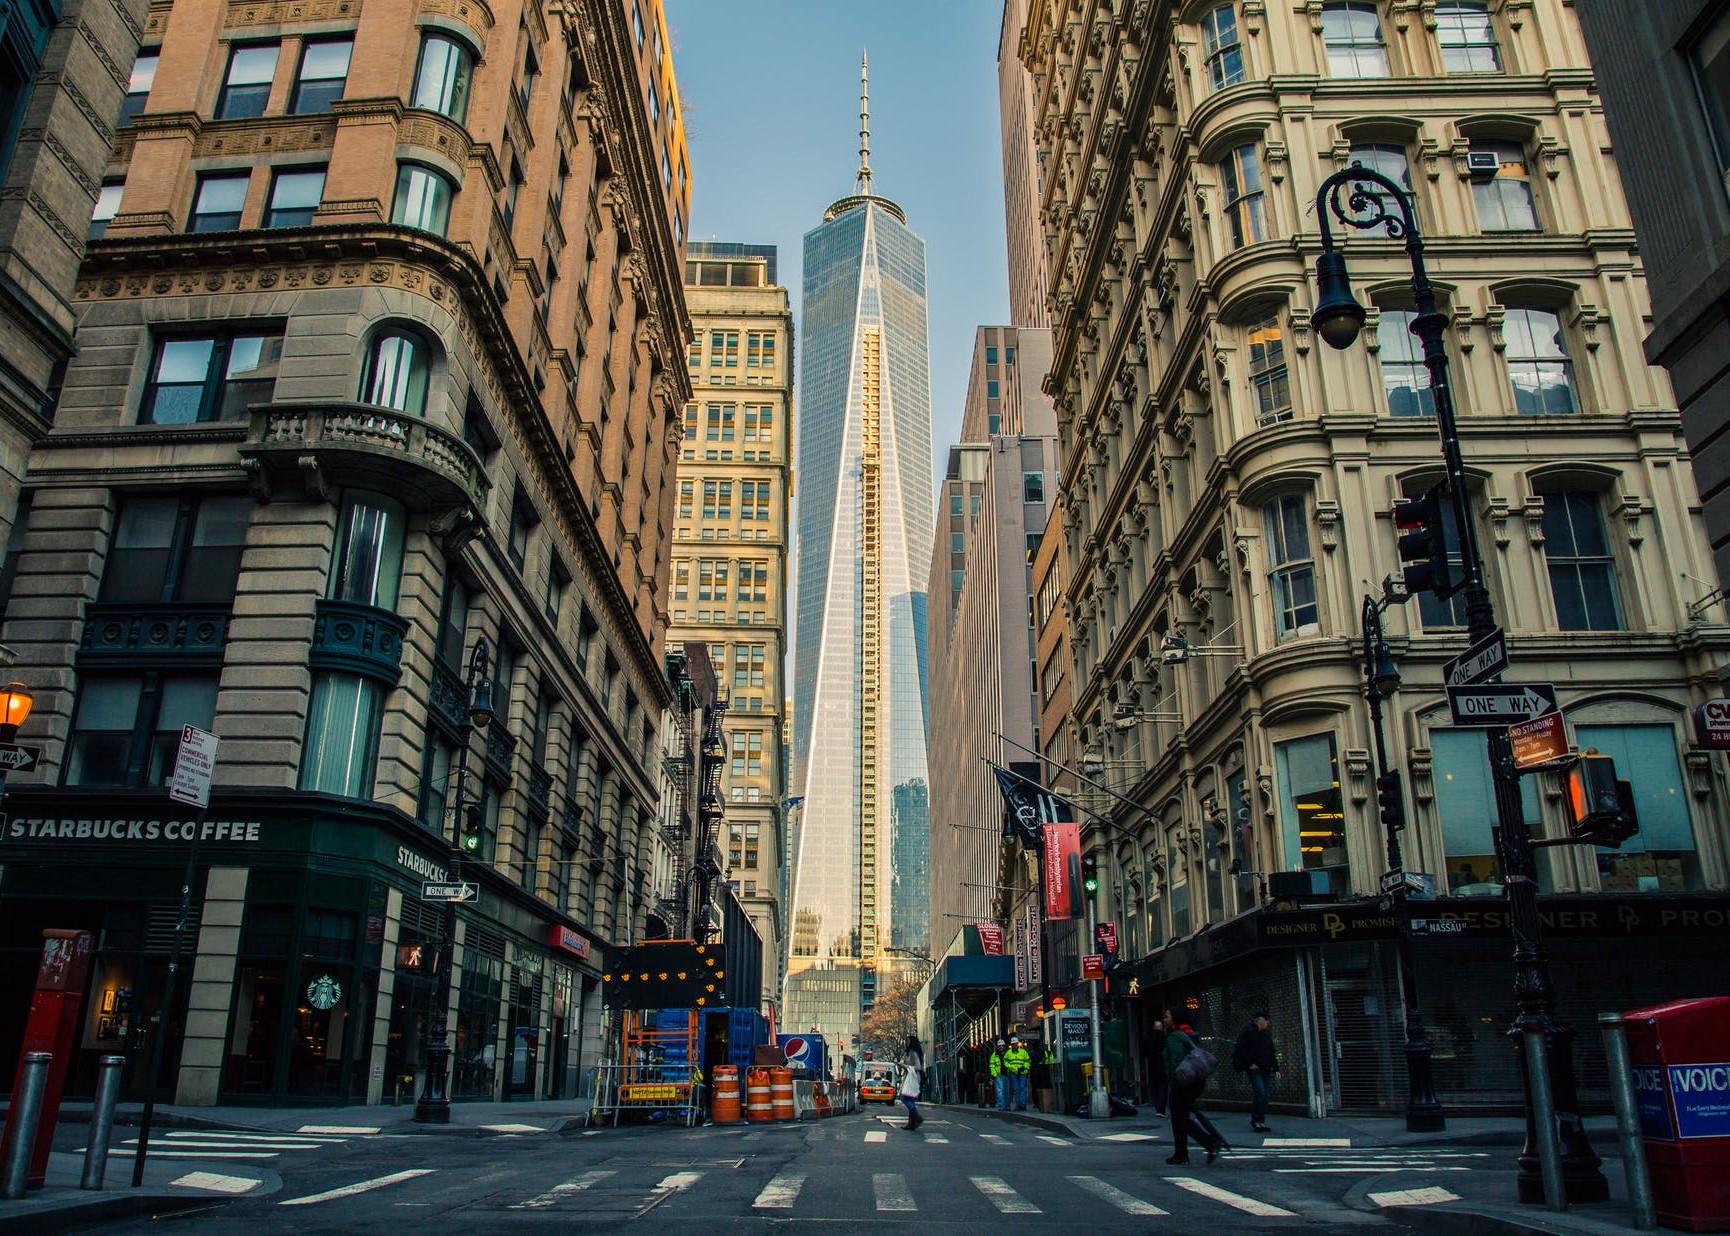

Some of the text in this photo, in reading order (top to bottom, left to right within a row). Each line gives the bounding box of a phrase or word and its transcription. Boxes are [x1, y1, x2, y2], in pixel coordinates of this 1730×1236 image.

[1453, 645, 1498, 684] ONE WAY
[1465, 697, 1540, 713] ONE WAY
[184, 727, 192, 742] 3
[1512, 718, 1554, 737] NO STANDING
[3, 751, 26, 764] WAY
[10, 819, 261, 841] STARBUCKS COFFEE
[398, 846, 444, 882] STARBUCKS
[430, 887, 471, 896] ONE WAY
[1266, 923, 1318, 935] DESIGNER
[1429, 921, 1462, 933] NASSAU
[1440, 911, 1597, 929] ESINER
[1030, 948, 1038, 982] Lucille
[1633, 1069, 1663, 1091] OICE
[1676, 1067, 1730, 1092] VOIC
